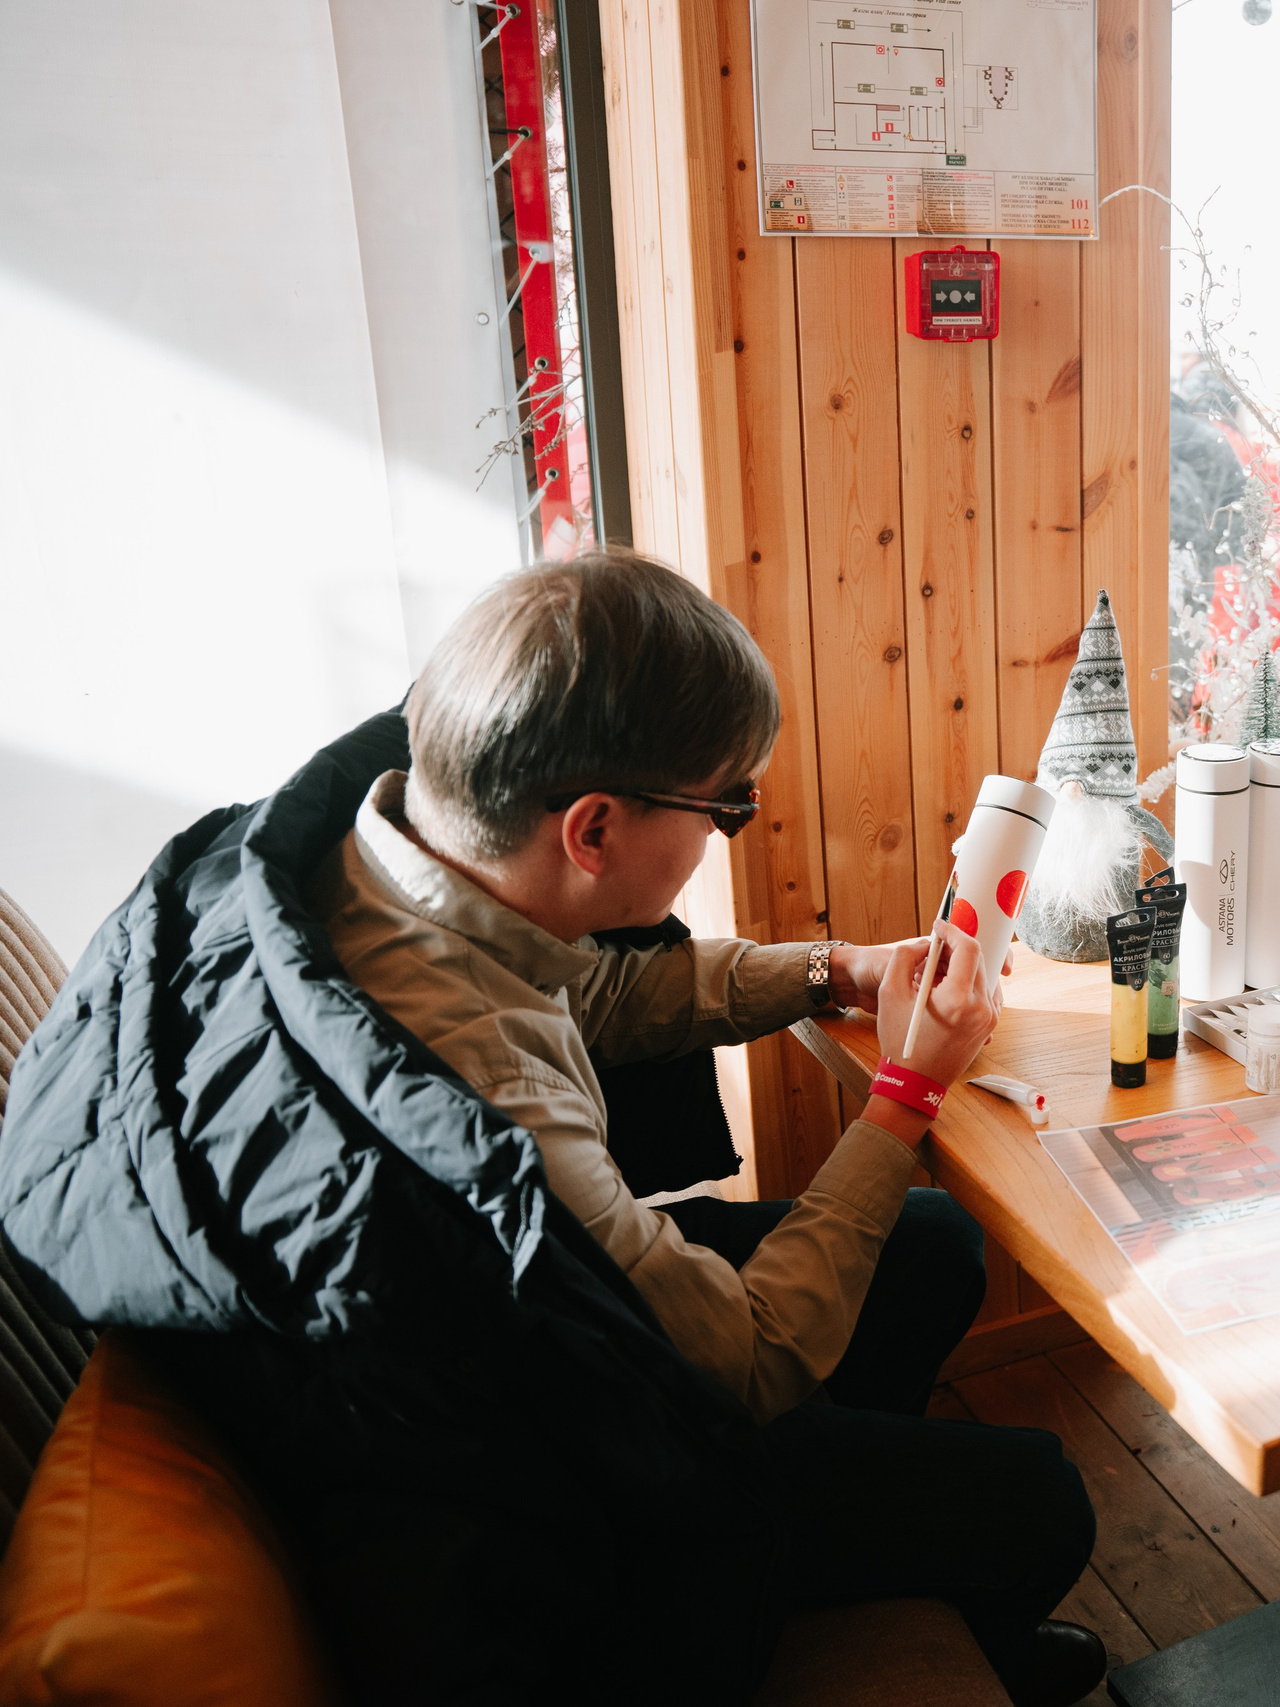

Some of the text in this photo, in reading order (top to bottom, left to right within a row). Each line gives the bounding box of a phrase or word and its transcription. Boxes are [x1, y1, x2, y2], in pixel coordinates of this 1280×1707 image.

[1070, 199, 1089, 210] 101
[1070, 219, 1090, 230] 112
[1218, 898, 1226, 932] ASTANA
[1226, 898, 1235, 946] MOTORS
[1113, 952, 1151, 963] АКРИЛОВЫ
[1121, 961, 1149, 972] КРАСКИ
[880, 1074, 905, 1087] Castrol
